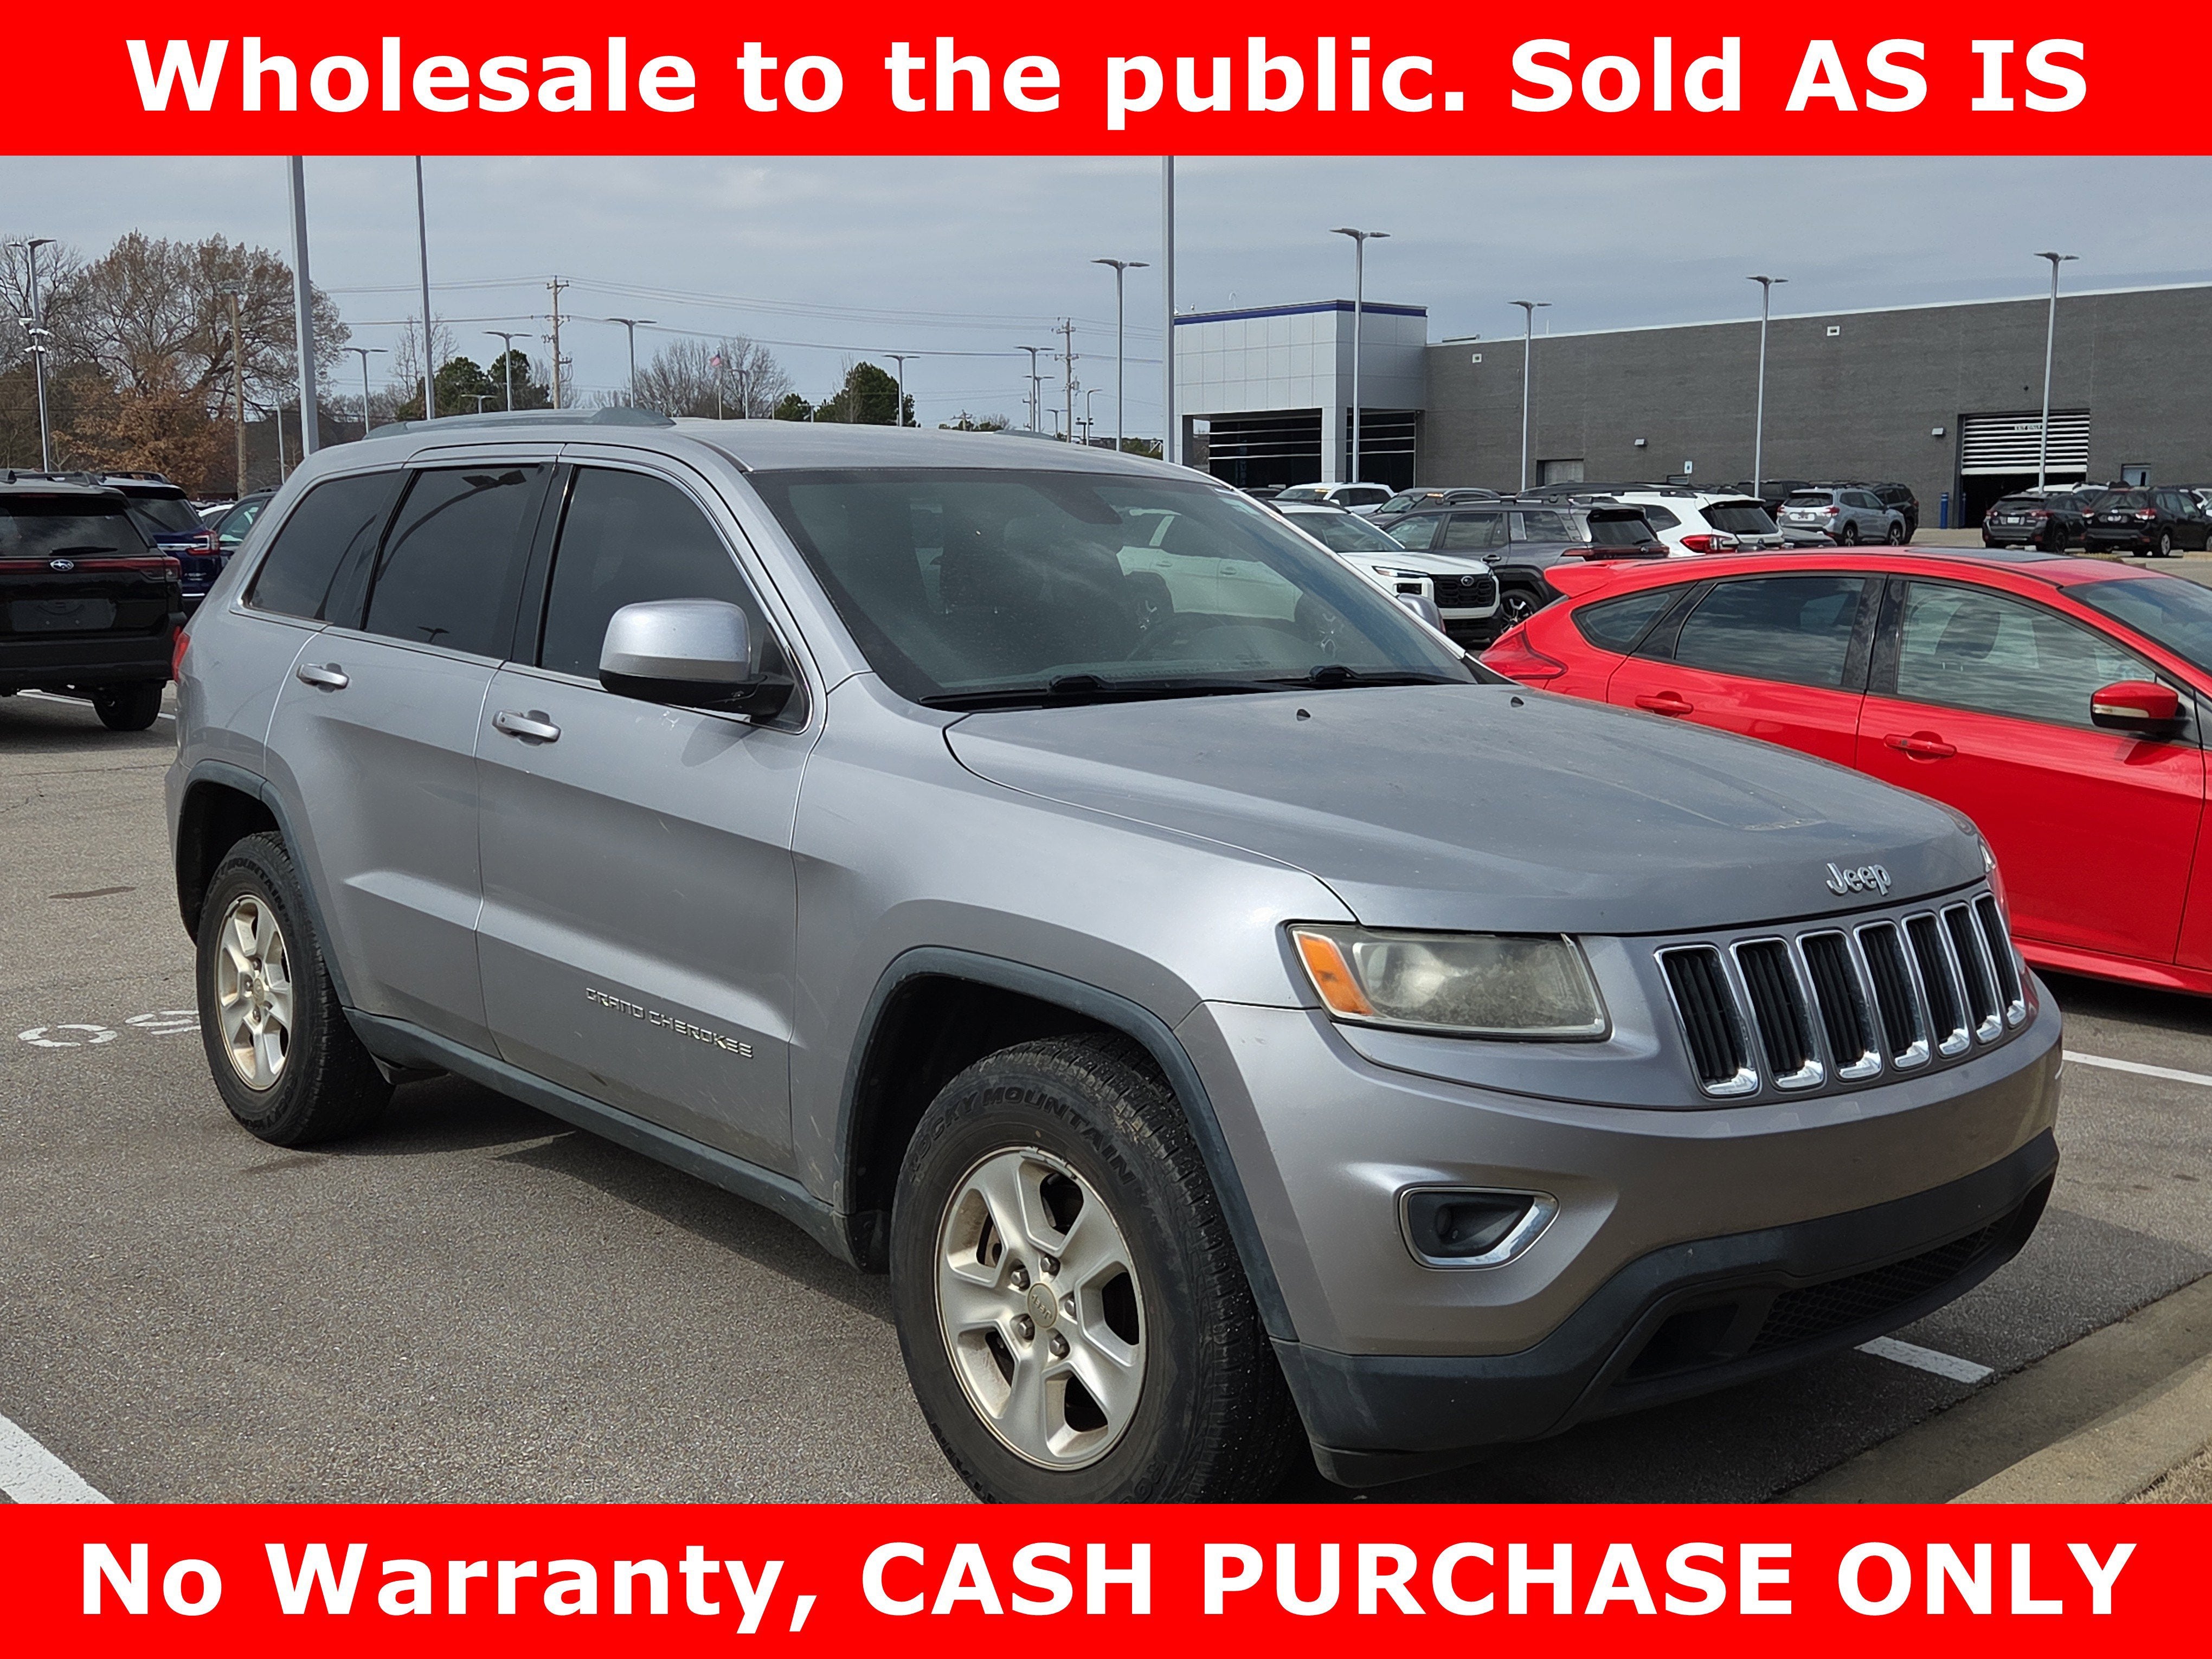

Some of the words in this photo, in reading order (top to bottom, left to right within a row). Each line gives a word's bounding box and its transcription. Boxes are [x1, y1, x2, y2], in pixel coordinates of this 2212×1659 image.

[1827, 862, 1891, 896] Jeep
[586, 987, 645, 1019] GRAND
[648, 1010, 754, 1058] CHEROKEE
[909, 1091, 978, 1184] ROCKY
[982, 1086, 1137, 1186] MOUNTAIN
[1031, 1294, 1052, 1320] Jeep
